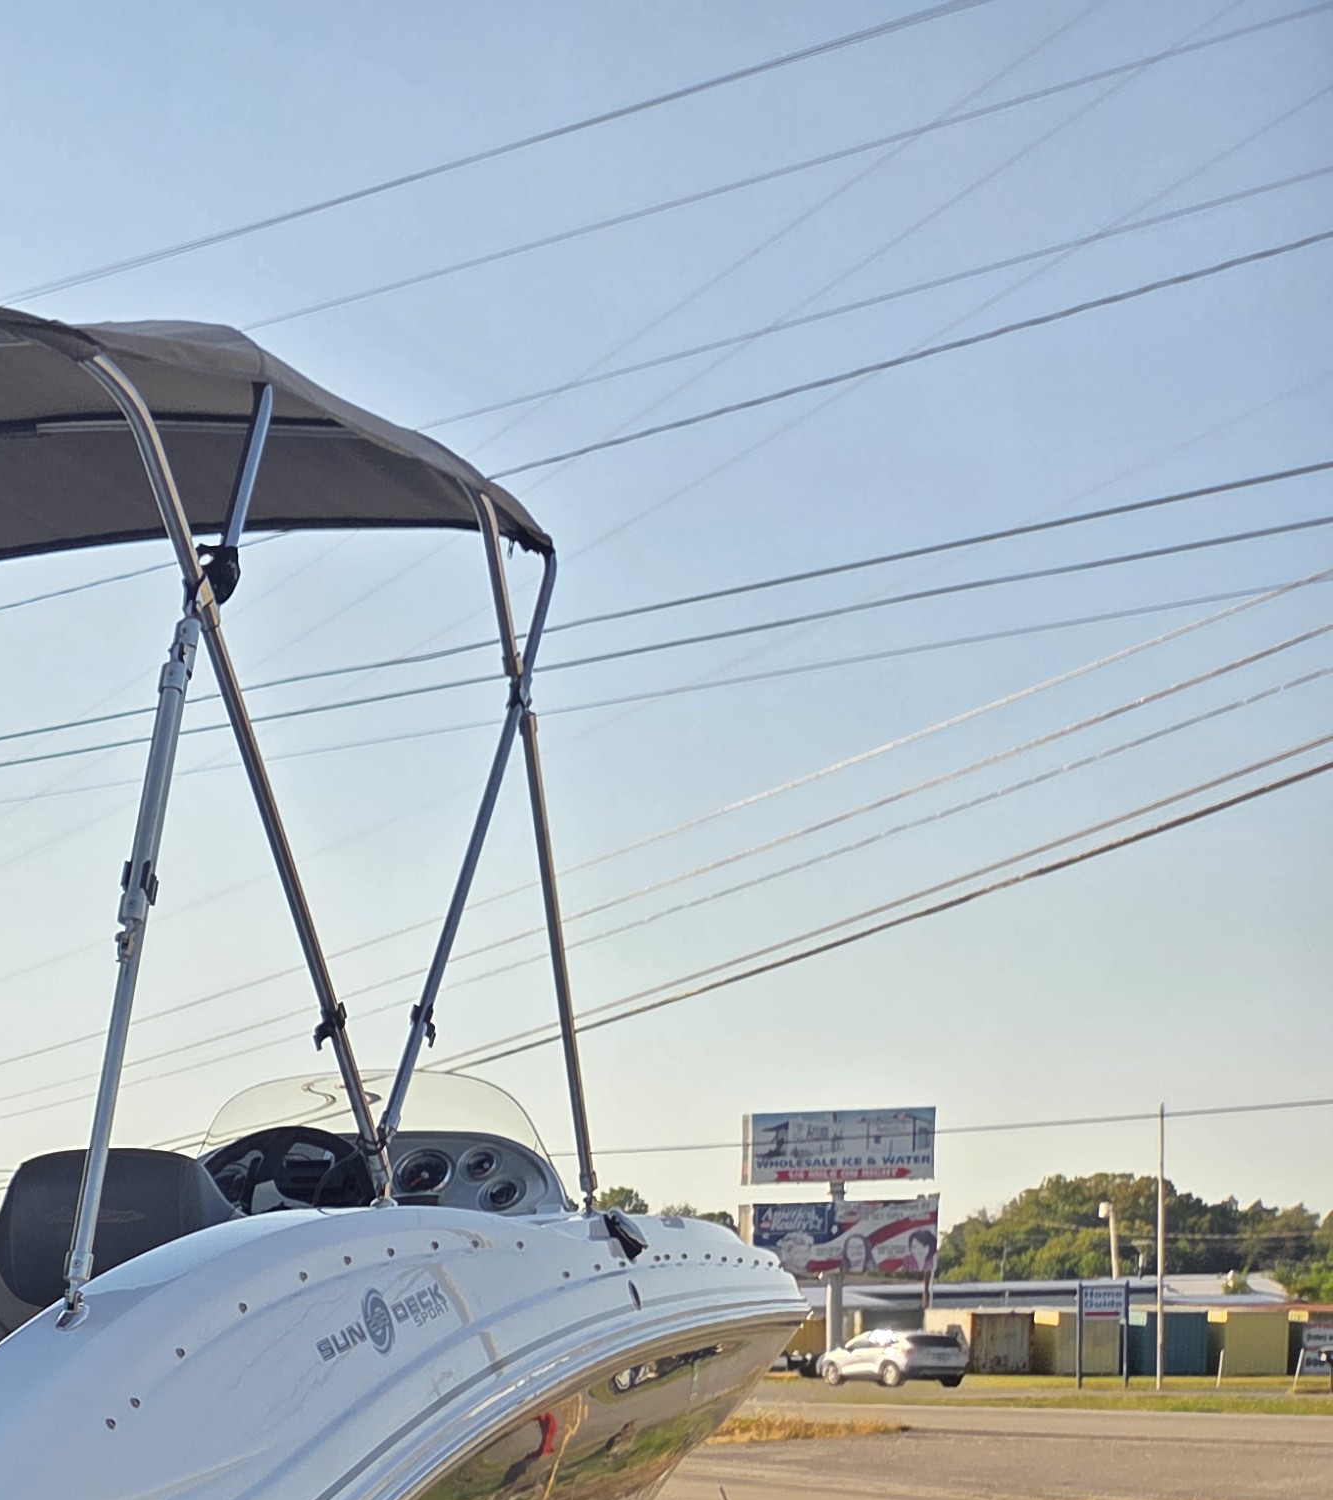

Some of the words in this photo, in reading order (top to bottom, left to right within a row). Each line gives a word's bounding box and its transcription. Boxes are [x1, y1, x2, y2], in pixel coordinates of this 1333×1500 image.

[756, 1157, 837, 1170] WHOLESALE
[842, 1156, 862, 1168] ICE
[883, 1154, 931, 1167] WATER
[841, 1168, 859, 1179] ON
[862, 1167, 897, 1178] RIGHT
[316, 1321, 368, 1361] SUN
[390, 1282, 448, 1324] DECK
[413, 1301, 450, 1327] SPORT
